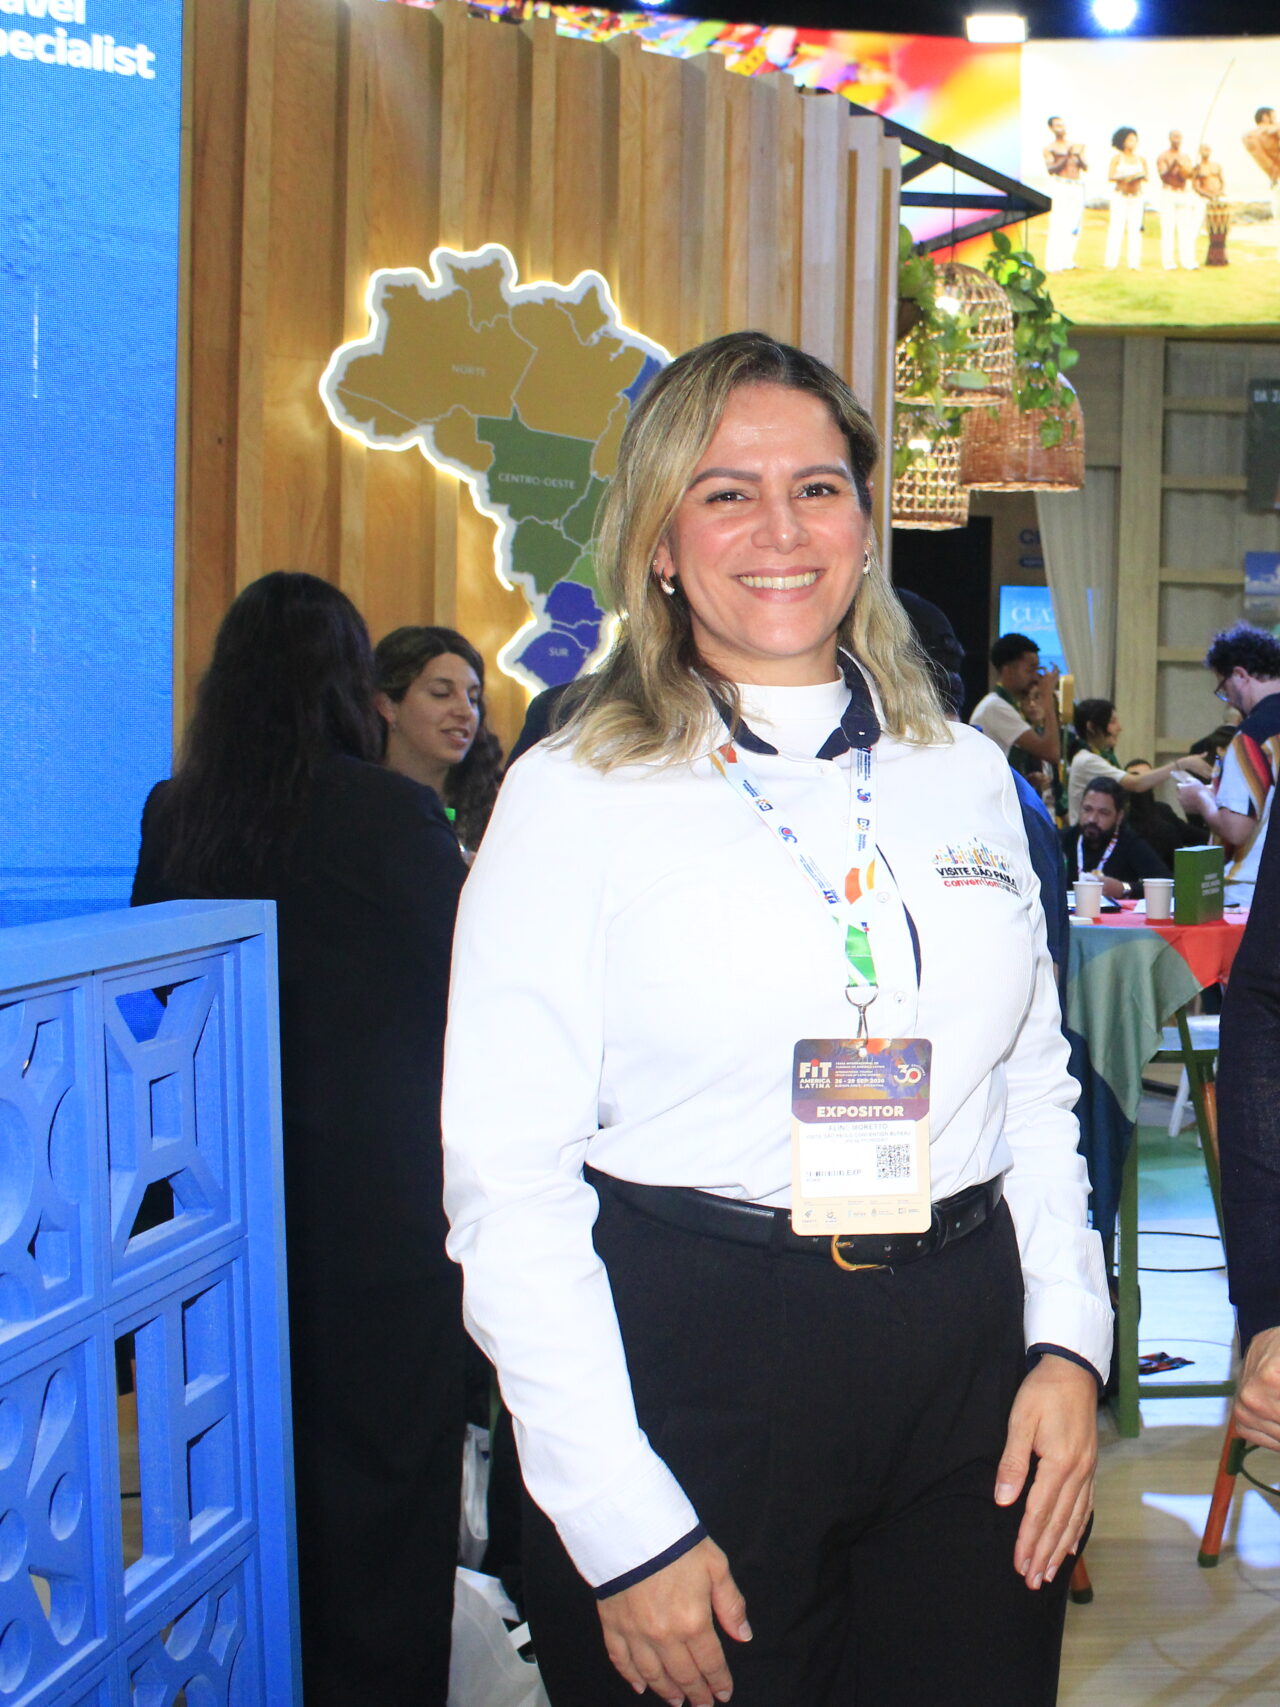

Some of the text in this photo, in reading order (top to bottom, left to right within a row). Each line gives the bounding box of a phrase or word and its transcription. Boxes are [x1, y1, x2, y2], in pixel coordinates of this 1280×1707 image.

[0, 27, 156, 80] ecialist
[452, 364, 487, 377] NORTE
[498, 473, 577, 489] CENTRO-OESTE
[548, 647, 569, 657] SUR
[936, 866, 972, 877] VISITE
[816, 1105, 905, 1118] EXPOSITOR
[851, 1123, 888, 1131] MORETTO
